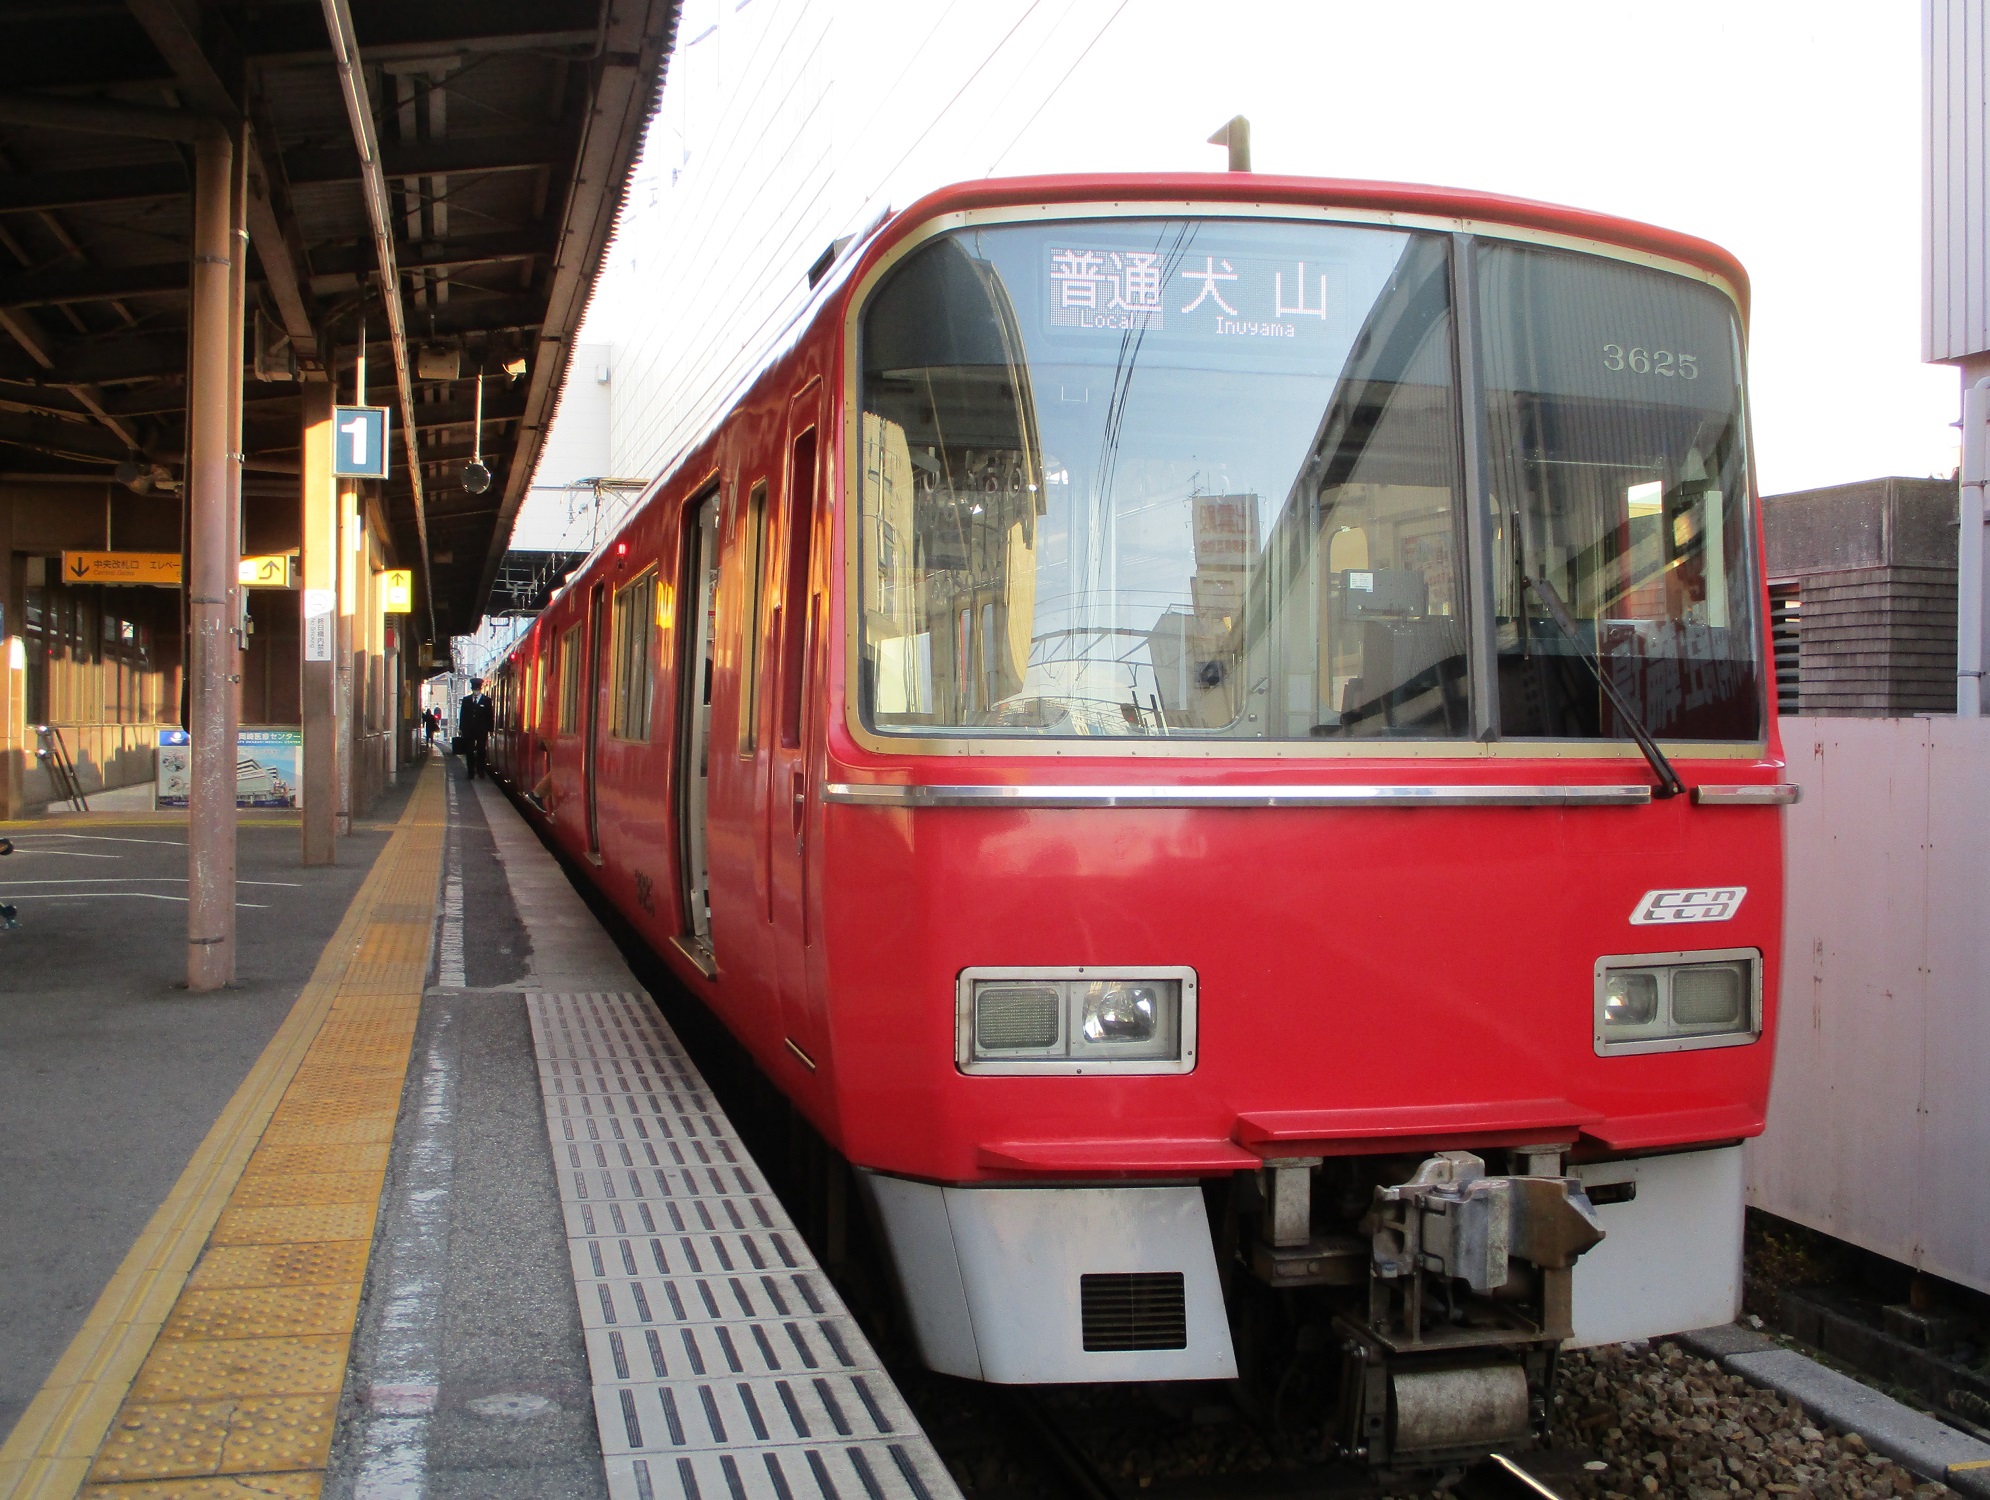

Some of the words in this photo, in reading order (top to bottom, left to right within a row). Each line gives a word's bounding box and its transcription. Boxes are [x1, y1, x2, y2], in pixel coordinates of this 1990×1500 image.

[1051, 249, 1161, 312] 普通
[1181, 256, 1326, 320] 犬山
[1080, 310, 1136, 330] Local
[1216, 316, 1295, 338] Inuyama
[1603, 343, 1699, 380] 3625
[340, 416, 368, 465] 1
